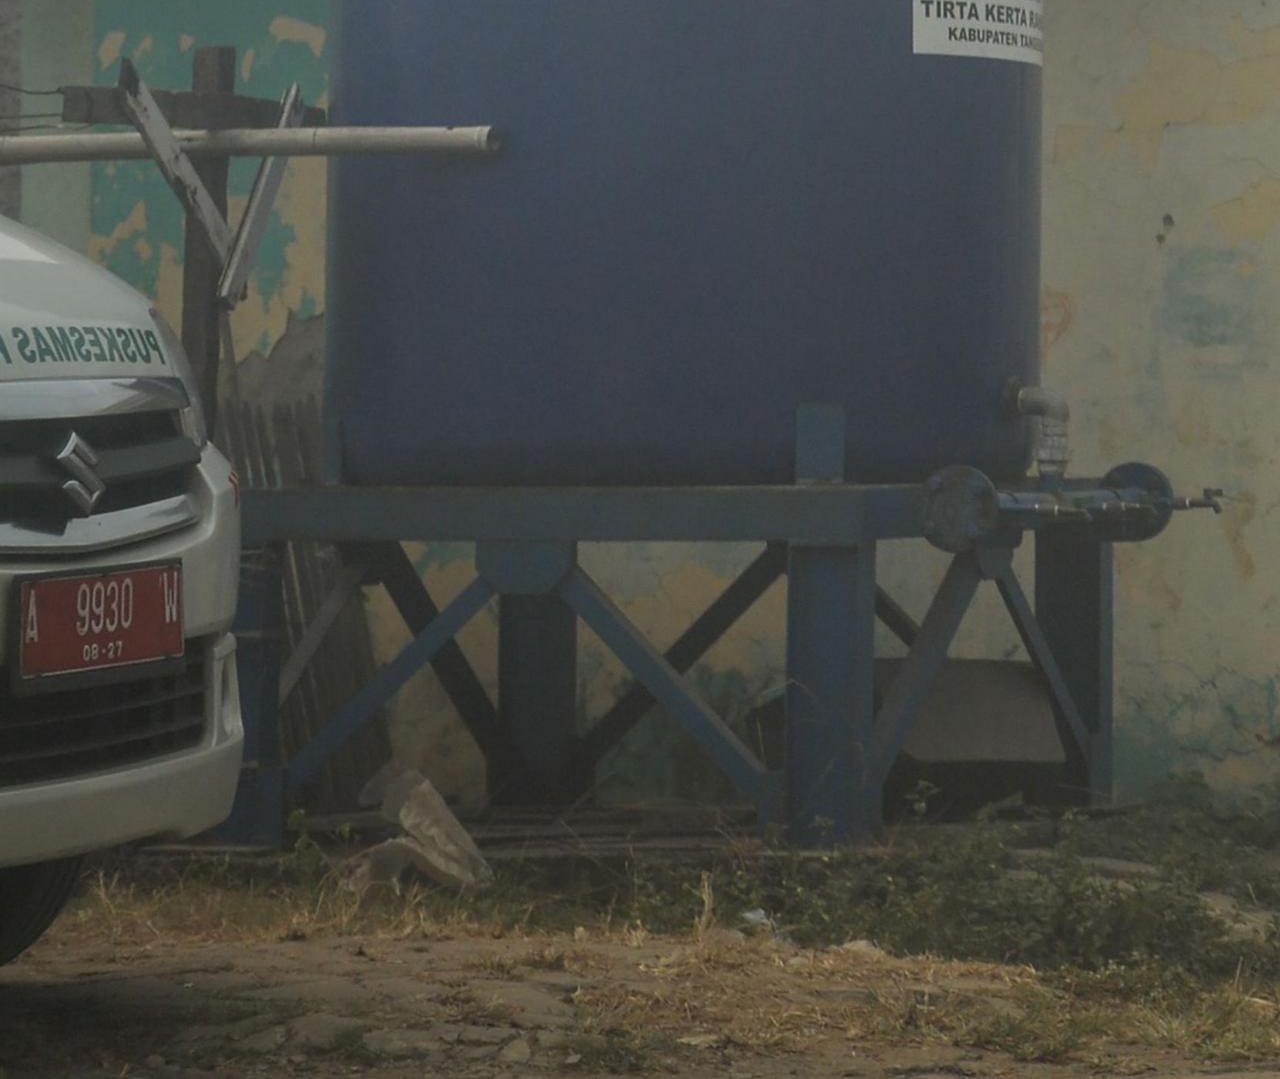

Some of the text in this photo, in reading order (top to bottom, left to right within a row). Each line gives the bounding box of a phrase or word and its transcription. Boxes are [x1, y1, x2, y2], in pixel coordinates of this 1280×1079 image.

[920, 0, 980, 21] TIRTA
[985, 3, 1027, 27] KERTA
[948, 26, 1018, 47] KABUPATEN
[25, 571, 178, 643] A 9930 W
